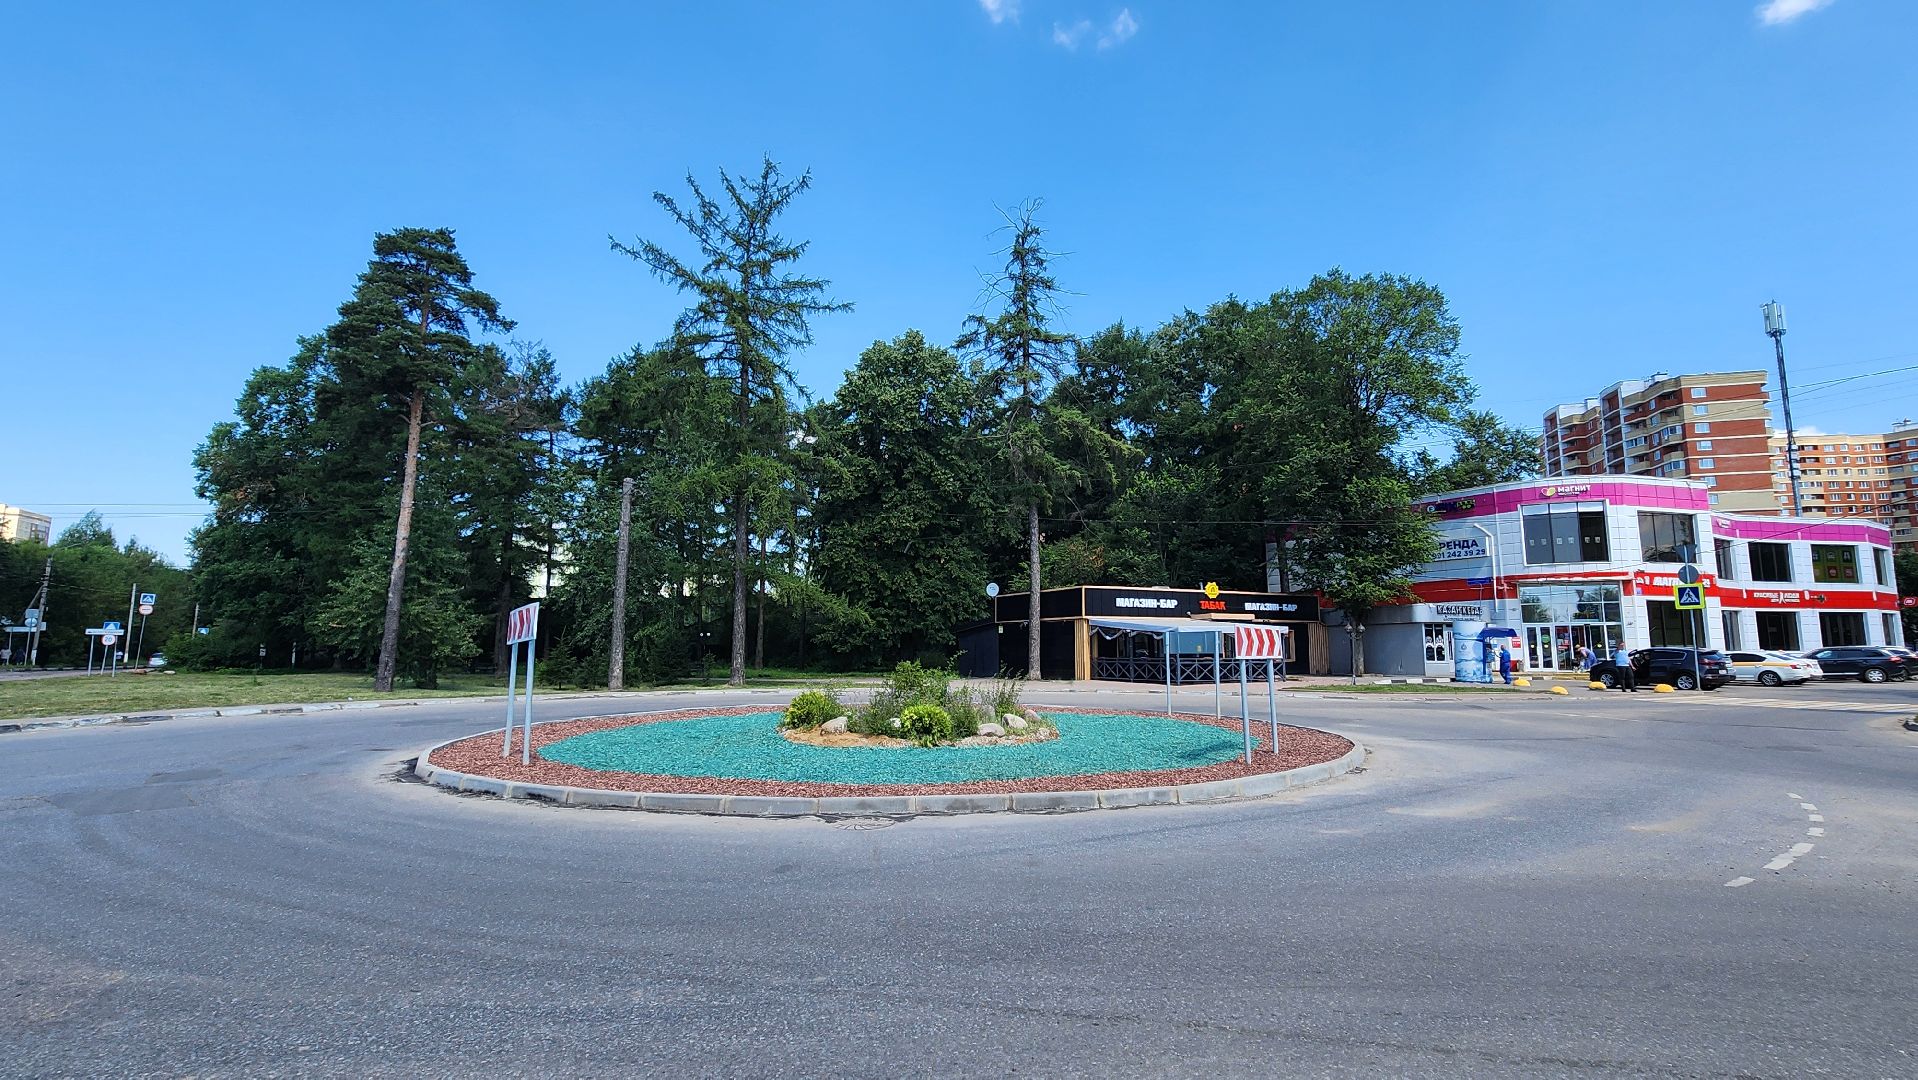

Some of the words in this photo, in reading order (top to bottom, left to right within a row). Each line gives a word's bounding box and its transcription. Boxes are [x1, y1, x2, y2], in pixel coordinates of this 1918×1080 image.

[1439, 539, 1479, 550] РЕНДА
[1464, 549, 1474, 557] 39
[1475, 548, 1486, 556] 29
[1115, 597, 1178, 609] МАГАЗИН-БАР
[1199, 600, 1226, 610] ТАБАК
[1244, 602, 1298, 612] МАГАЗИН-БАР
